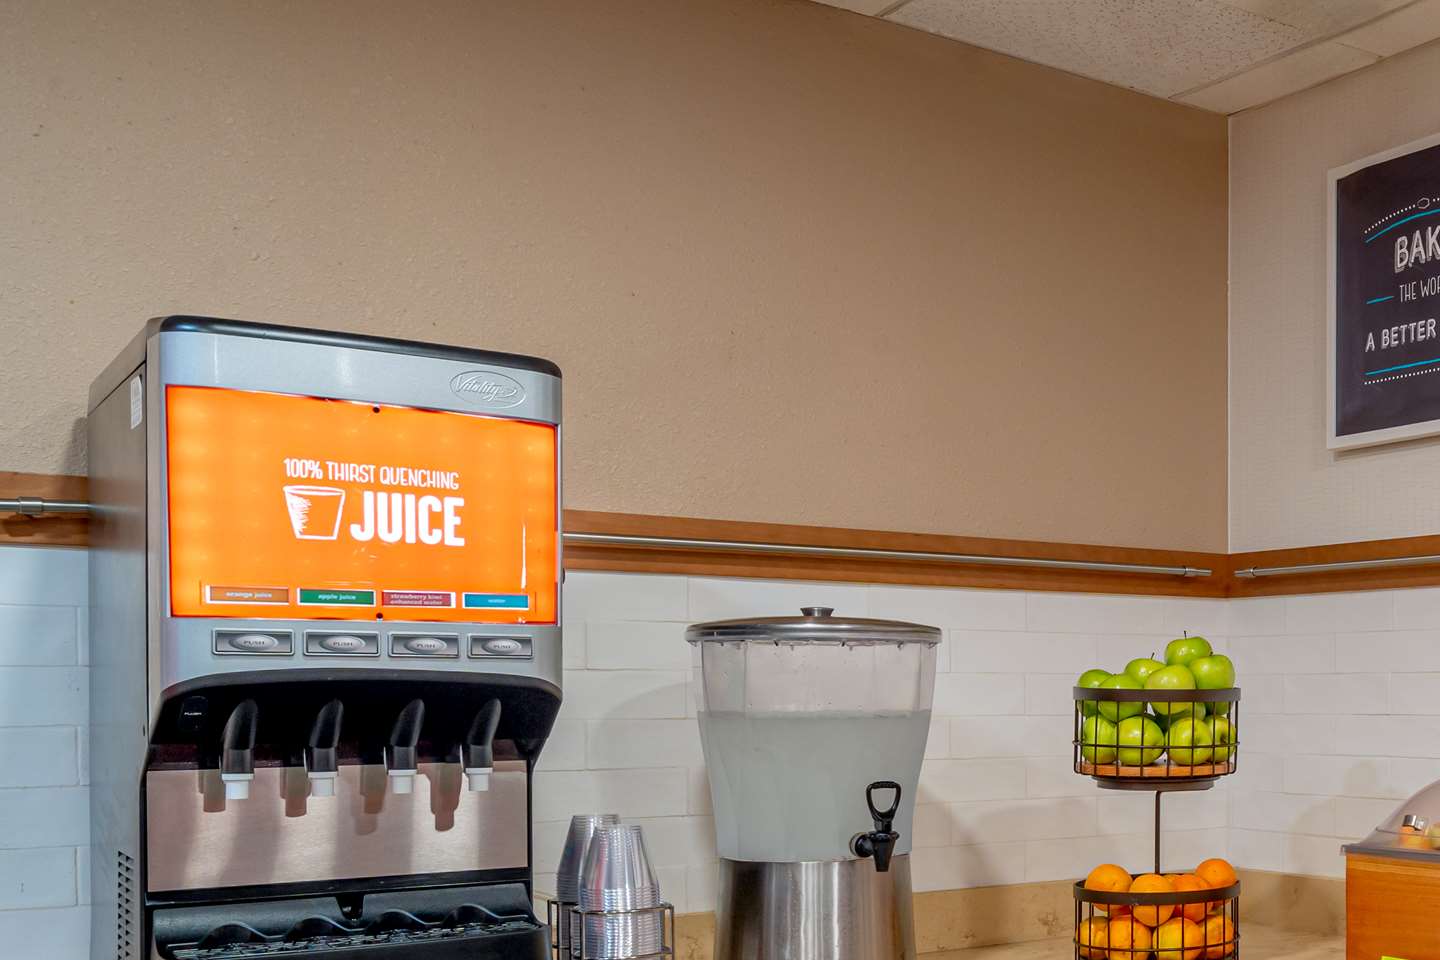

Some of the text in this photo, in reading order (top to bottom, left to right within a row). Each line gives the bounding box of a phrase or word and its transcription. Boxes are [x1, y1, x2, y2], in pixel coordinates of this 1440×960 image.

[1399, 281, 1416, 303] THE
[1365, 332, 1376, 353] A
[1381, 318, 1437, 349] BETTER
[283, 458, 460, 490] 100% THIRST QUENCHING
[350, 490, 465, 547] JUICE
[318, 593, 356, 601] apple juice
